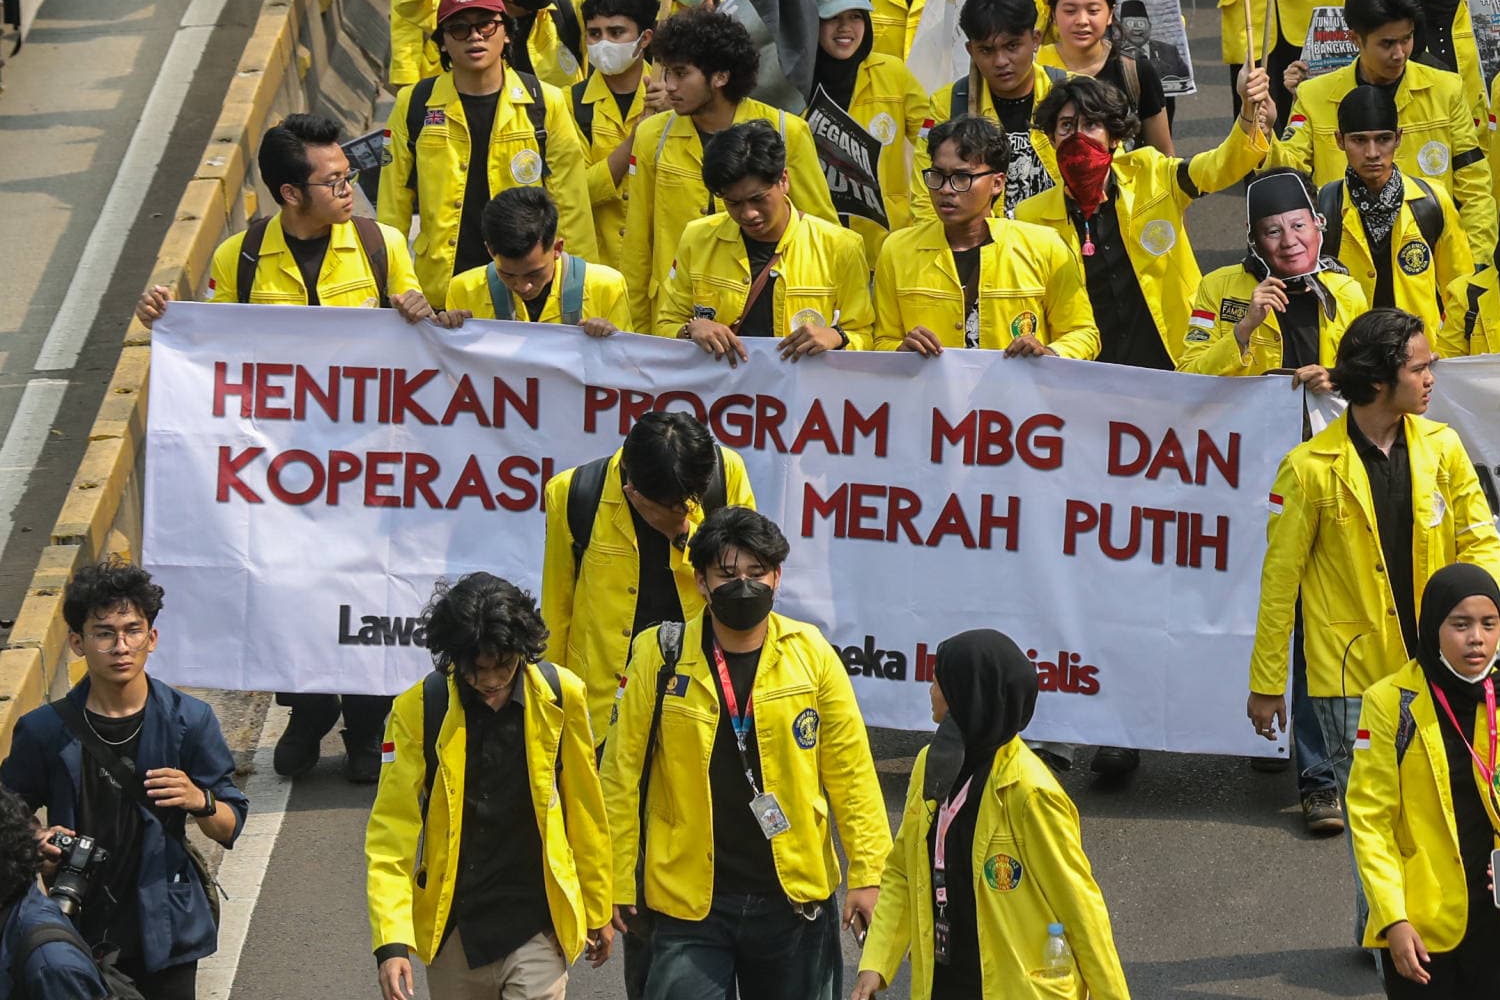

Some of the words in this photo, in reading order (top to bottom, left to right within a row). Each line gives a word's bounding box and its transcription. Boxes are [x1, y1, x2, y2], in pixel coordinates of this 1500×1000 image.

[808, 108, 877, 184] NEGARA
[212, 360, 540, 430] HENTIKAN
[930, 406, 1066, 471] MBG
[1106, 420, 1242, 489] DAN
[215, 444, 554, 513] KOPERASI
[800, 481, 1021, 552] MERAH
[1062, 498, 1230, 572] PUTIH
[338, 604, 428, 648] Lawa
